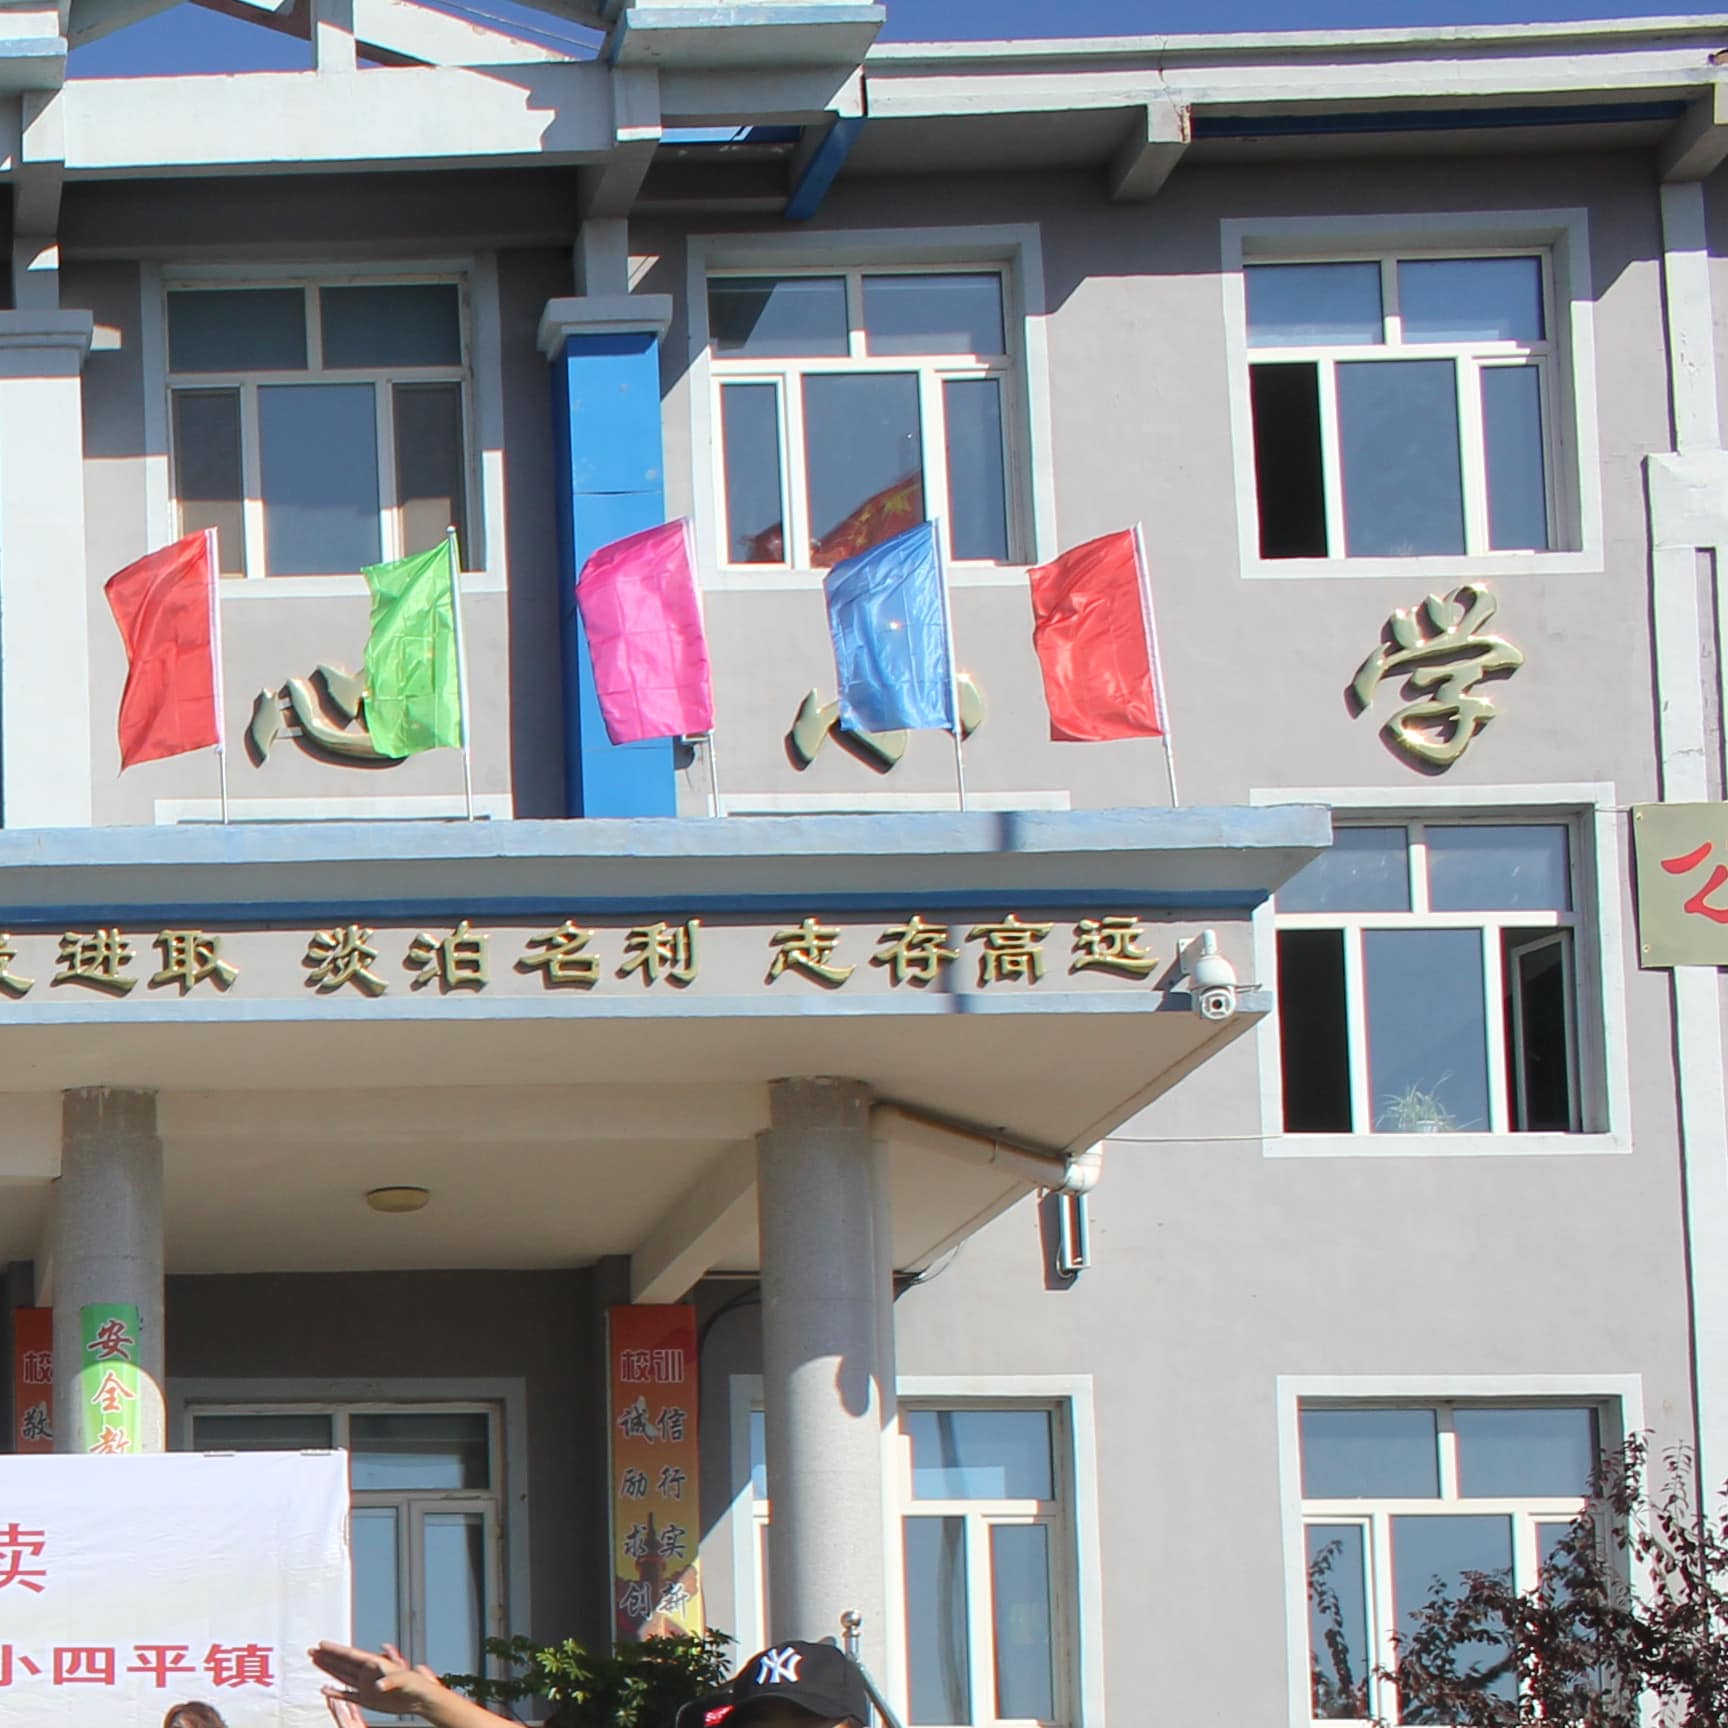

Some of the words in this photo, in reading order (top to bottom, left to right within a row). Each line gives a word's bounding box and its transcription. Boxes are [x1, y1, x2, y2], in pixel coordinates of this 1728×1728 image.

[304, 916, 702, 998] 淡泊名利
[766, 914, 1160, 988] 志存高远
[619, 1349, 685, 1383] 校训
[617, 1397, 688, 1444] 诚信
[619, 1465, 688, 1499] 励行
[755, 1646, 803, 1685] NY
